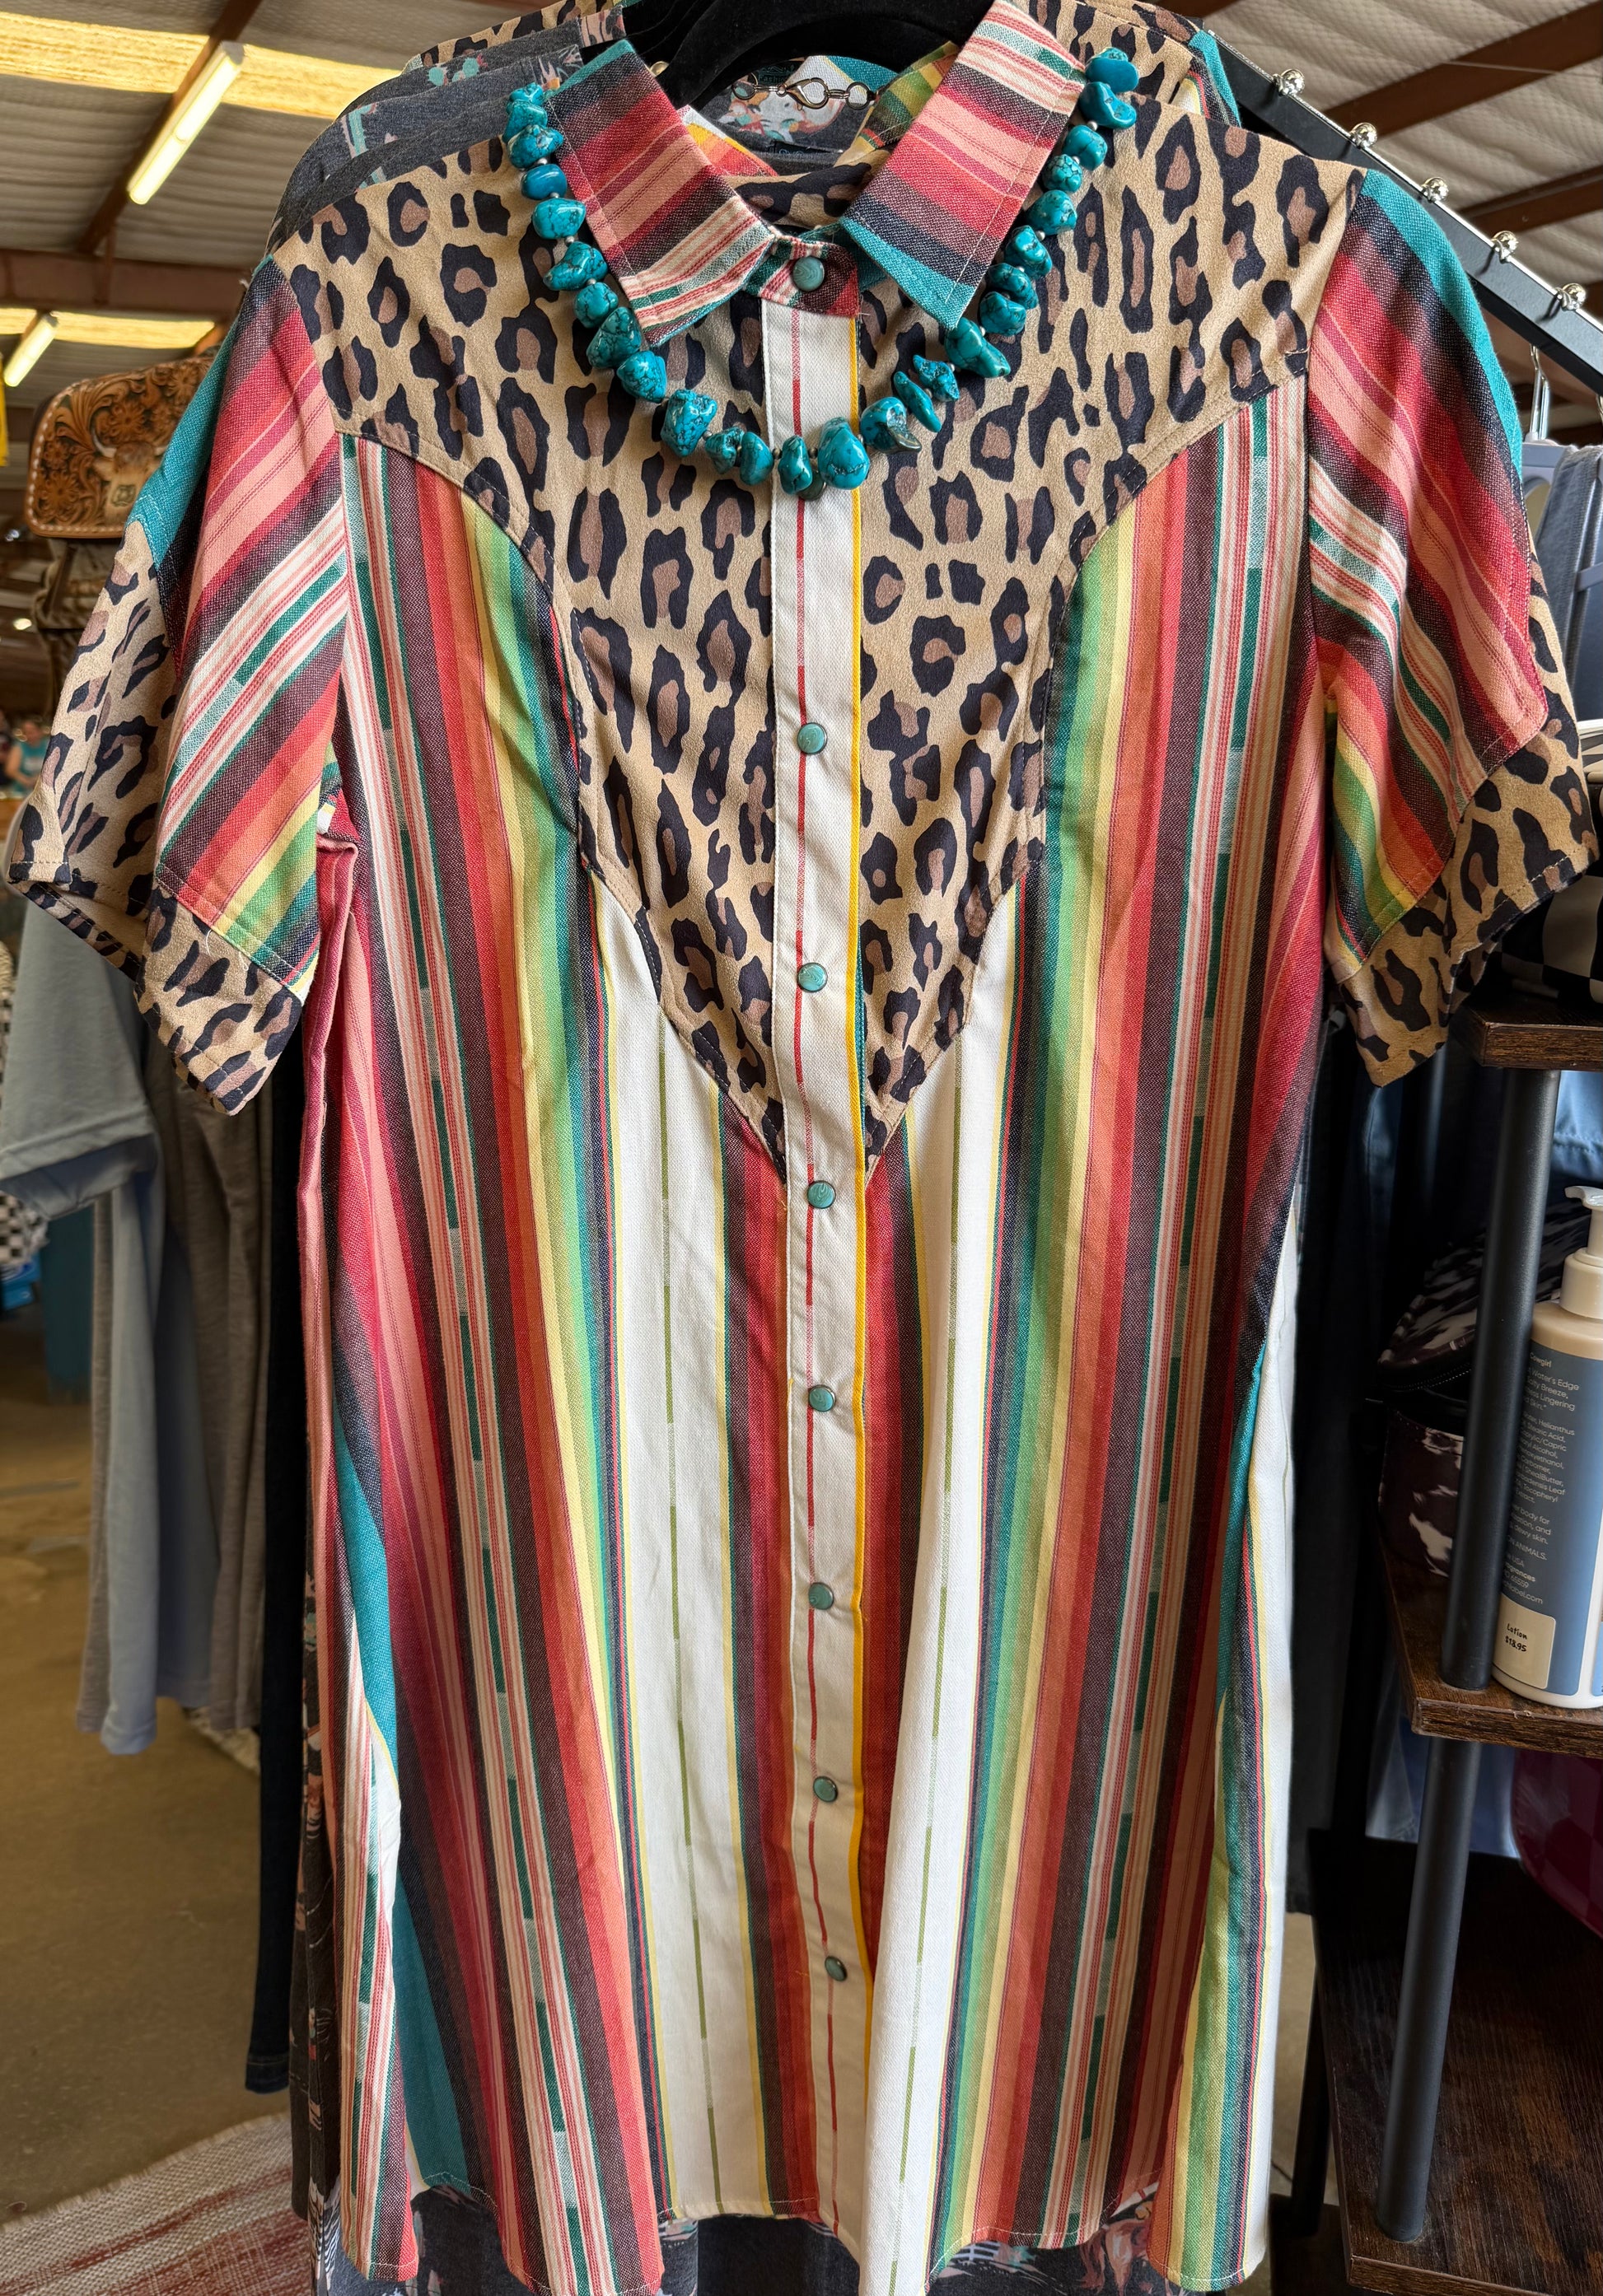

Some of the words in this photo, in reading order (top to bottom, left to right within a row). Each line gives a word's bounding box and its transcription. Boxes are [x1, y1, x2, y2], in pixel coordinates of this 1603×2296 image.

[1530, 1352, 1552, 1367] Cowgirl
[1532, 1370, 1556, 1384] Water's
[1557, 1379, 1580, 1391] Edge
[1540, 1393, 1576, 1412] Lingering
[1539, 1418, 1575, 1435] Helianthus
[1532, 1444, 1558, 1458] Alcohol,
[1549, 1485, 1566, 1496] Leaf
[1520, 1507, 1538, 1521] body
[1539, 1515, 1550, 1525] for
[1535, 1525, 1551, 1536] and
[1531, 1533, 1549, 1546] skin.
[1515, 1541, 1548, 1561] ANIMALS.
[1507, 1623, 1528, 1640] Lotion
[1504, 1636, 1527, 1652] $18.95
